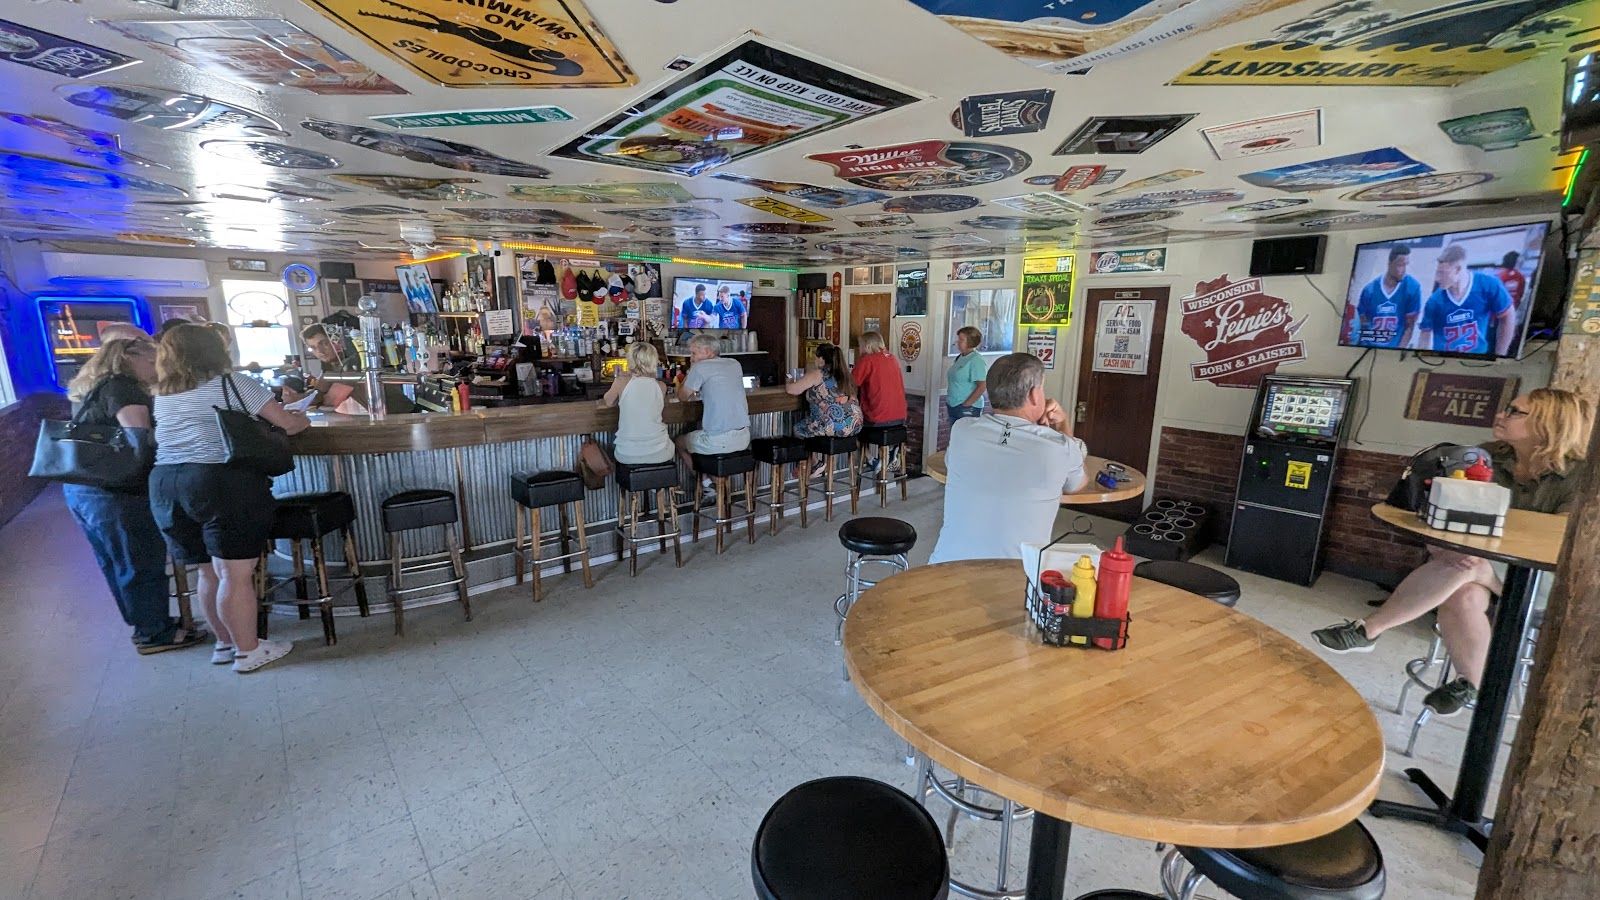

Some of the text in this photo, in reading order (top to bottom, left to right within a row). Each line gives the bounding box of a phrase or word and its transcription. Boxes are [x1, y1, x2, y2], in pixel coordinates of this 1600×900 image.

[441, 0, 578, 40] SWIMMI
[484, 13, 526, 31] NO
[1148, 24, 1193, 44] FILLING
[392, 39, 532, 80] CROCODILES
[733, 65, 757, 79] ICE
[1187, 60, 1418, 78] LANDSHARK
[757, 73, 778, 85] ON
[777, 82, 809, 95] KEEP
[816, 93, 842, 106] COLD
[845, 101, 877, 113] SERVE
[468, 112, 537, 123] Miller
[977, 98, 1002, 133] SAMUEL
[1000, 98, 1026, 128] ADAMS
[840, 149, 922, 166] Miller
[849, 161, 938, 173] HIGH LIFE
[1187, 282, 1256, 311] WISCONSIN
[1128, 319, 1142, 327] FOOD
[1204, 300, 1286, 351] Leinie's
[1443, 320, 1478, 352] 23
[1037, 348, 1053, 362] $2
[1103, 358, 1136, 369] CASH ONLY
[1200, 346, 1297, 377] BORN & RAISED
[1431, 390, 1491, 401] AMERICAN
[1443, 399, 1488, 419] ALE
